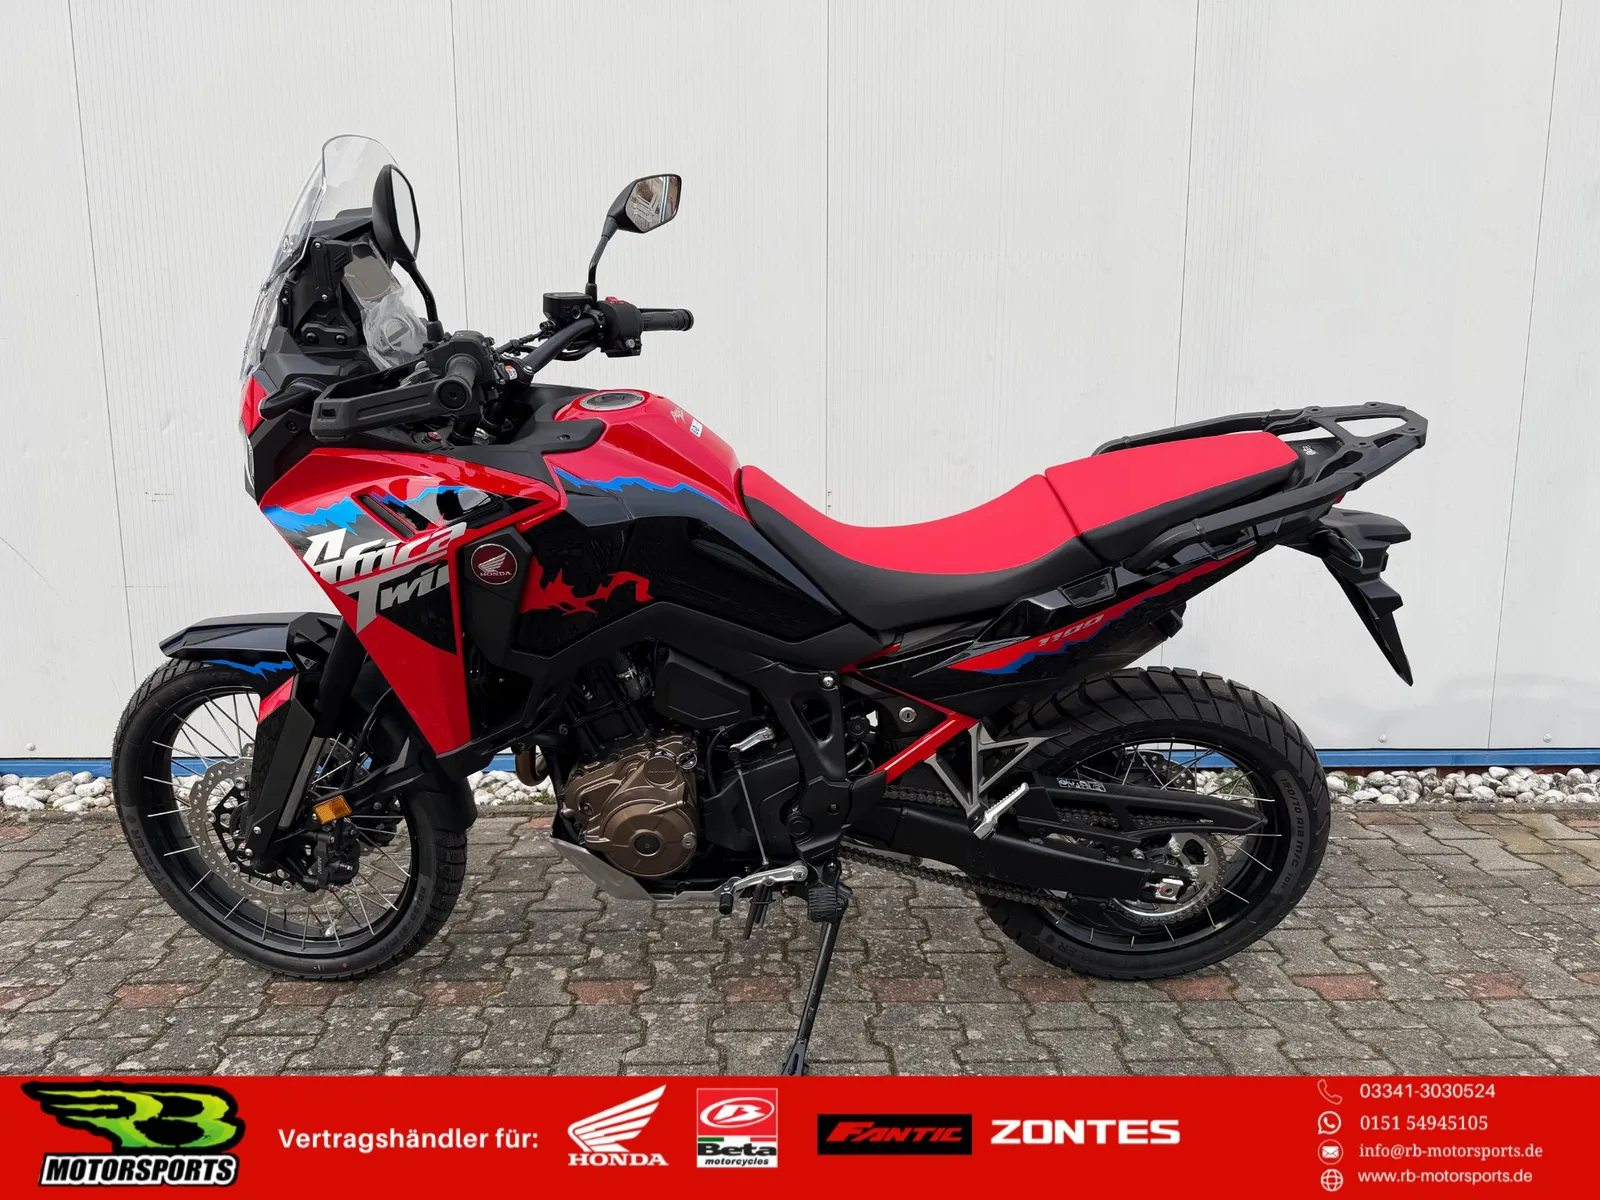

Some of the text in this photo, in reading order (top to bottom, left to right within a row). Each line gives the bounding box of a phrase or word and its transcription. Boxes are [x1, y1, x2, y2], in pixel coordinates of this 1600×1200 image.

[301, 522, 468, 585] Africa
[1038, 613, 1105, 647] 1100
[130, 829, 182, 904] METZELER
